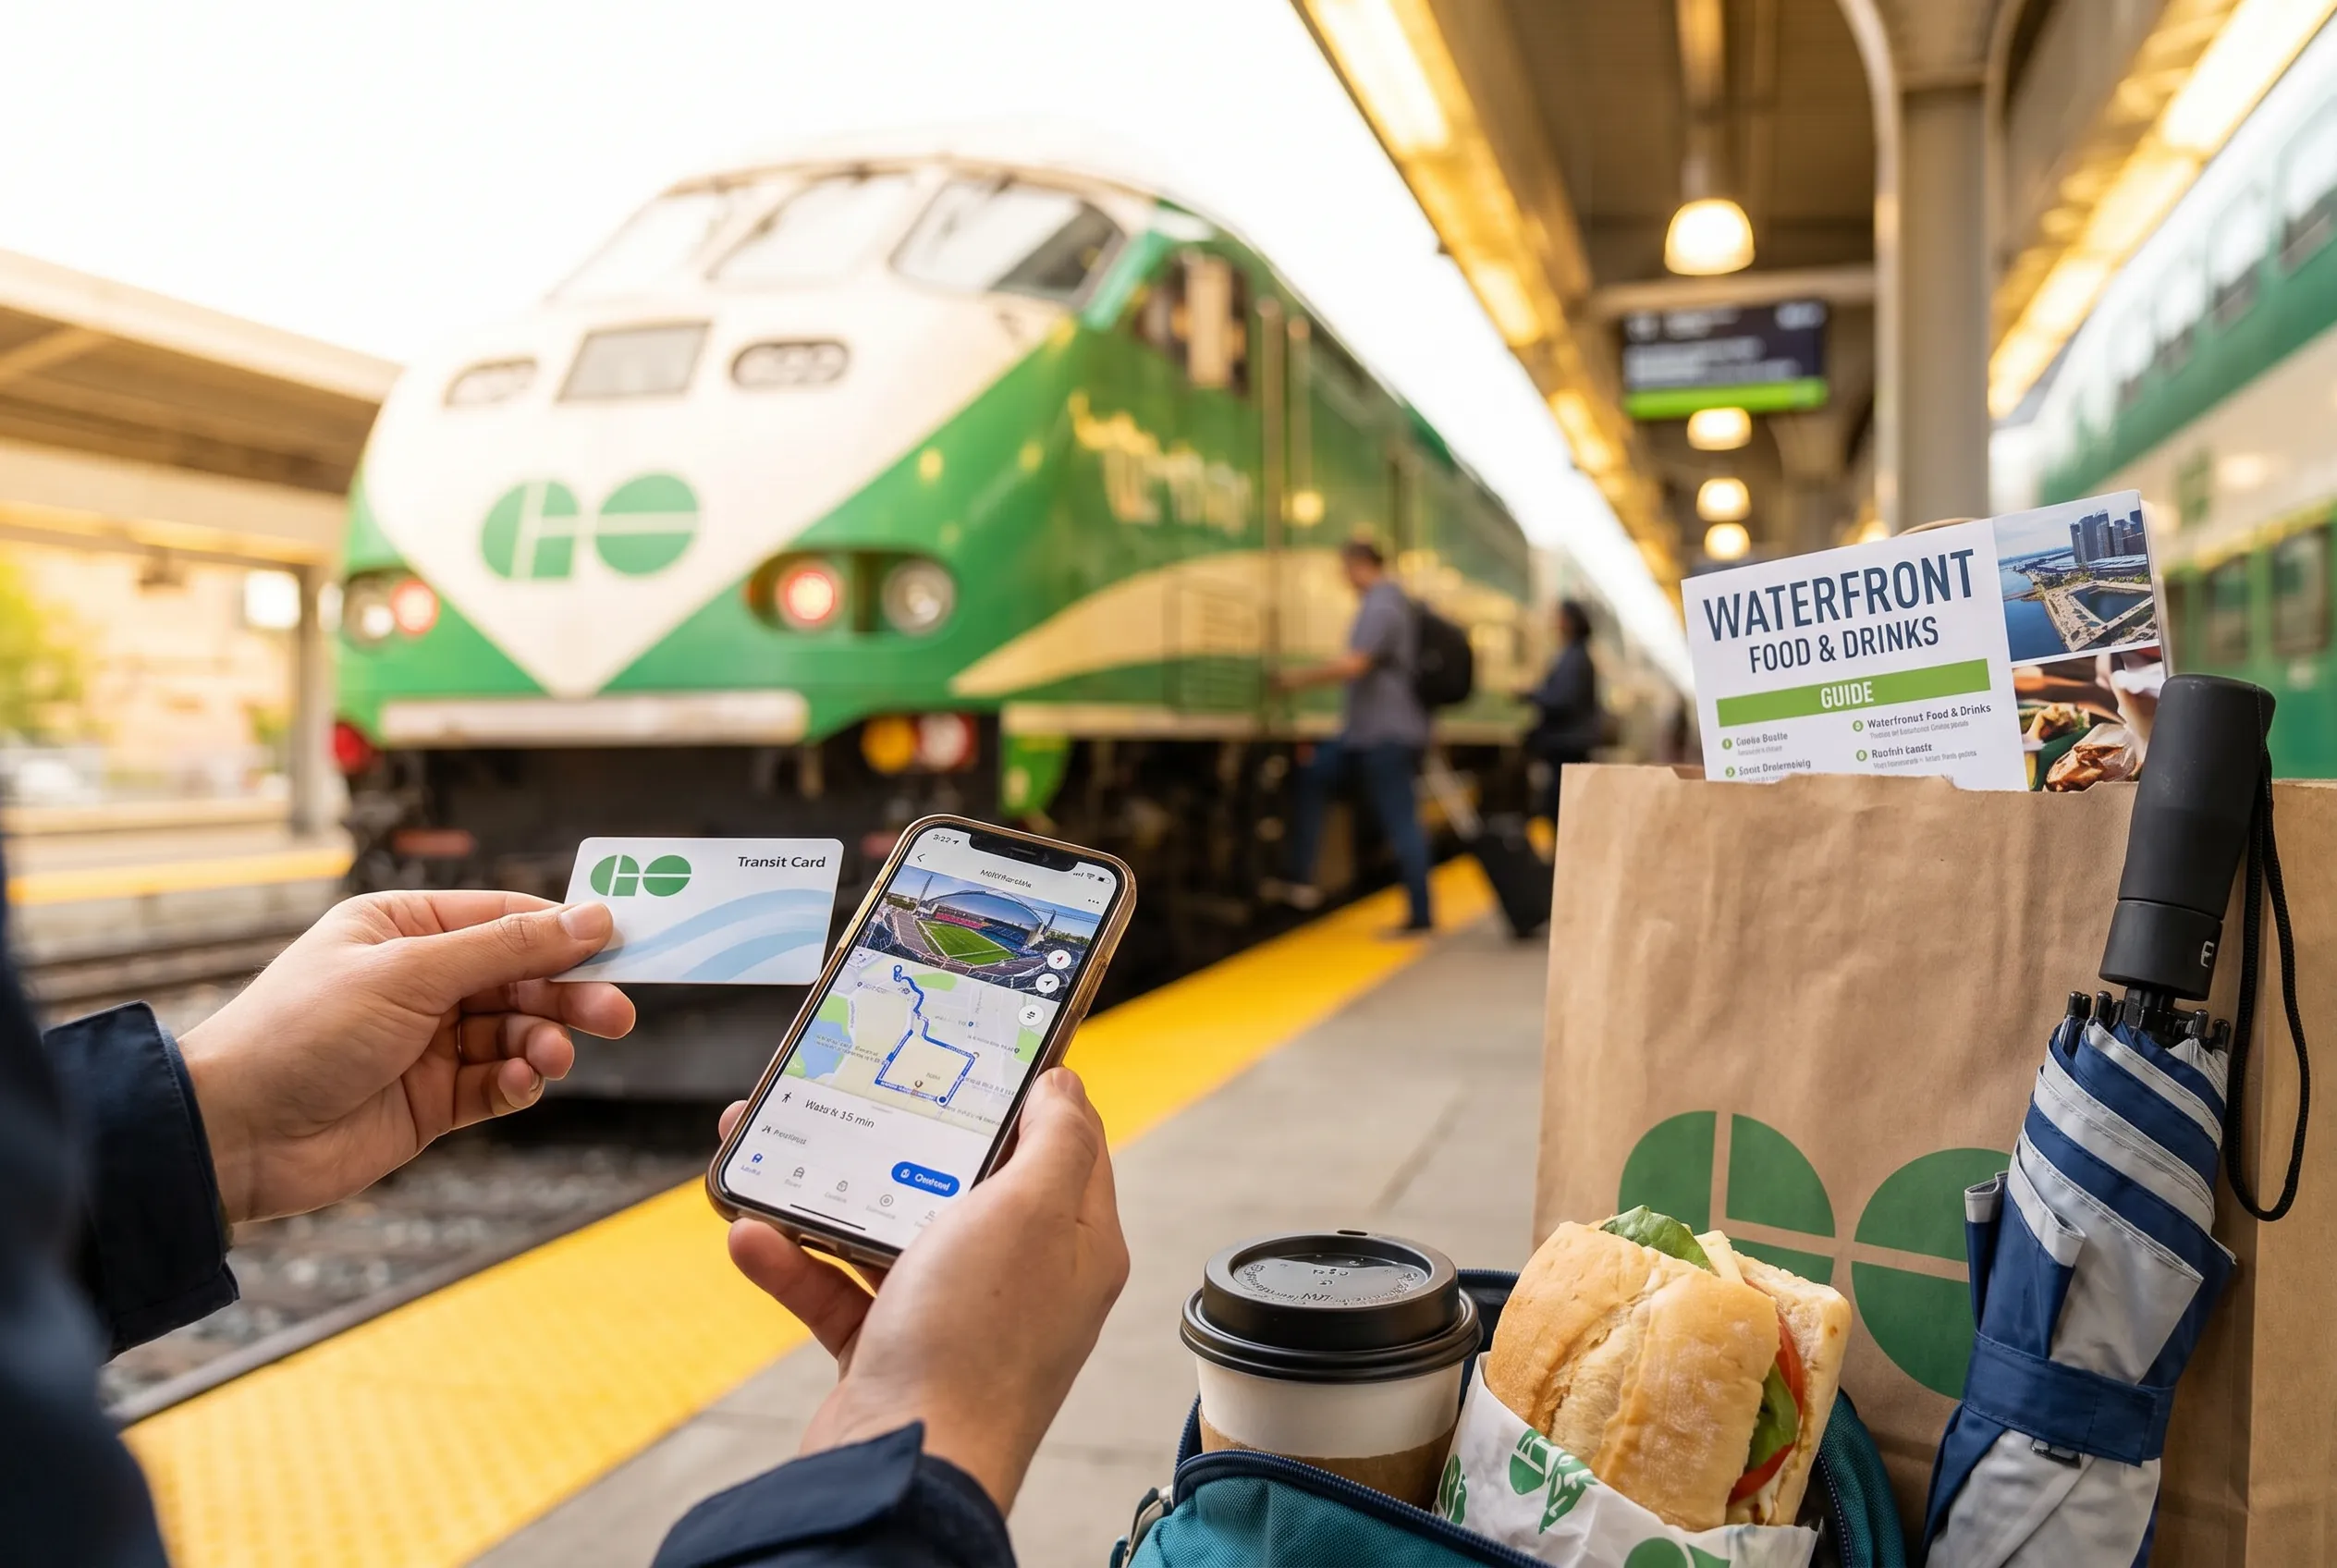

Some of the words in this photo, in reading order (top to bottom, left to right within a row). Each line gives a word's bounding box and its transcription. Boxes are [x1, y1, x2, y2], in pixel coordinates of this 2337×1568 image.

[481, 472, 700, 580] GO
[1703, 549, 1974, 642] WATERFRONT
[1749, 638, 1811, 673] FOOD
[1819, 634, 1836, 663] &
[1842, 617, 1939, 659] DRINKS
[1820, 681, 1874, 709] GUIDE
[1927, 710, 1949, 721] Food
[1951, 708, 1958, 717] &
[1960, 704, 1991, 717] Drinks
[590, 854, 691, 897] GO
[738, 856, 788, 868] Transit
[790, 856, 826, 868] Card
[855, 1116, 875, 1129] min
